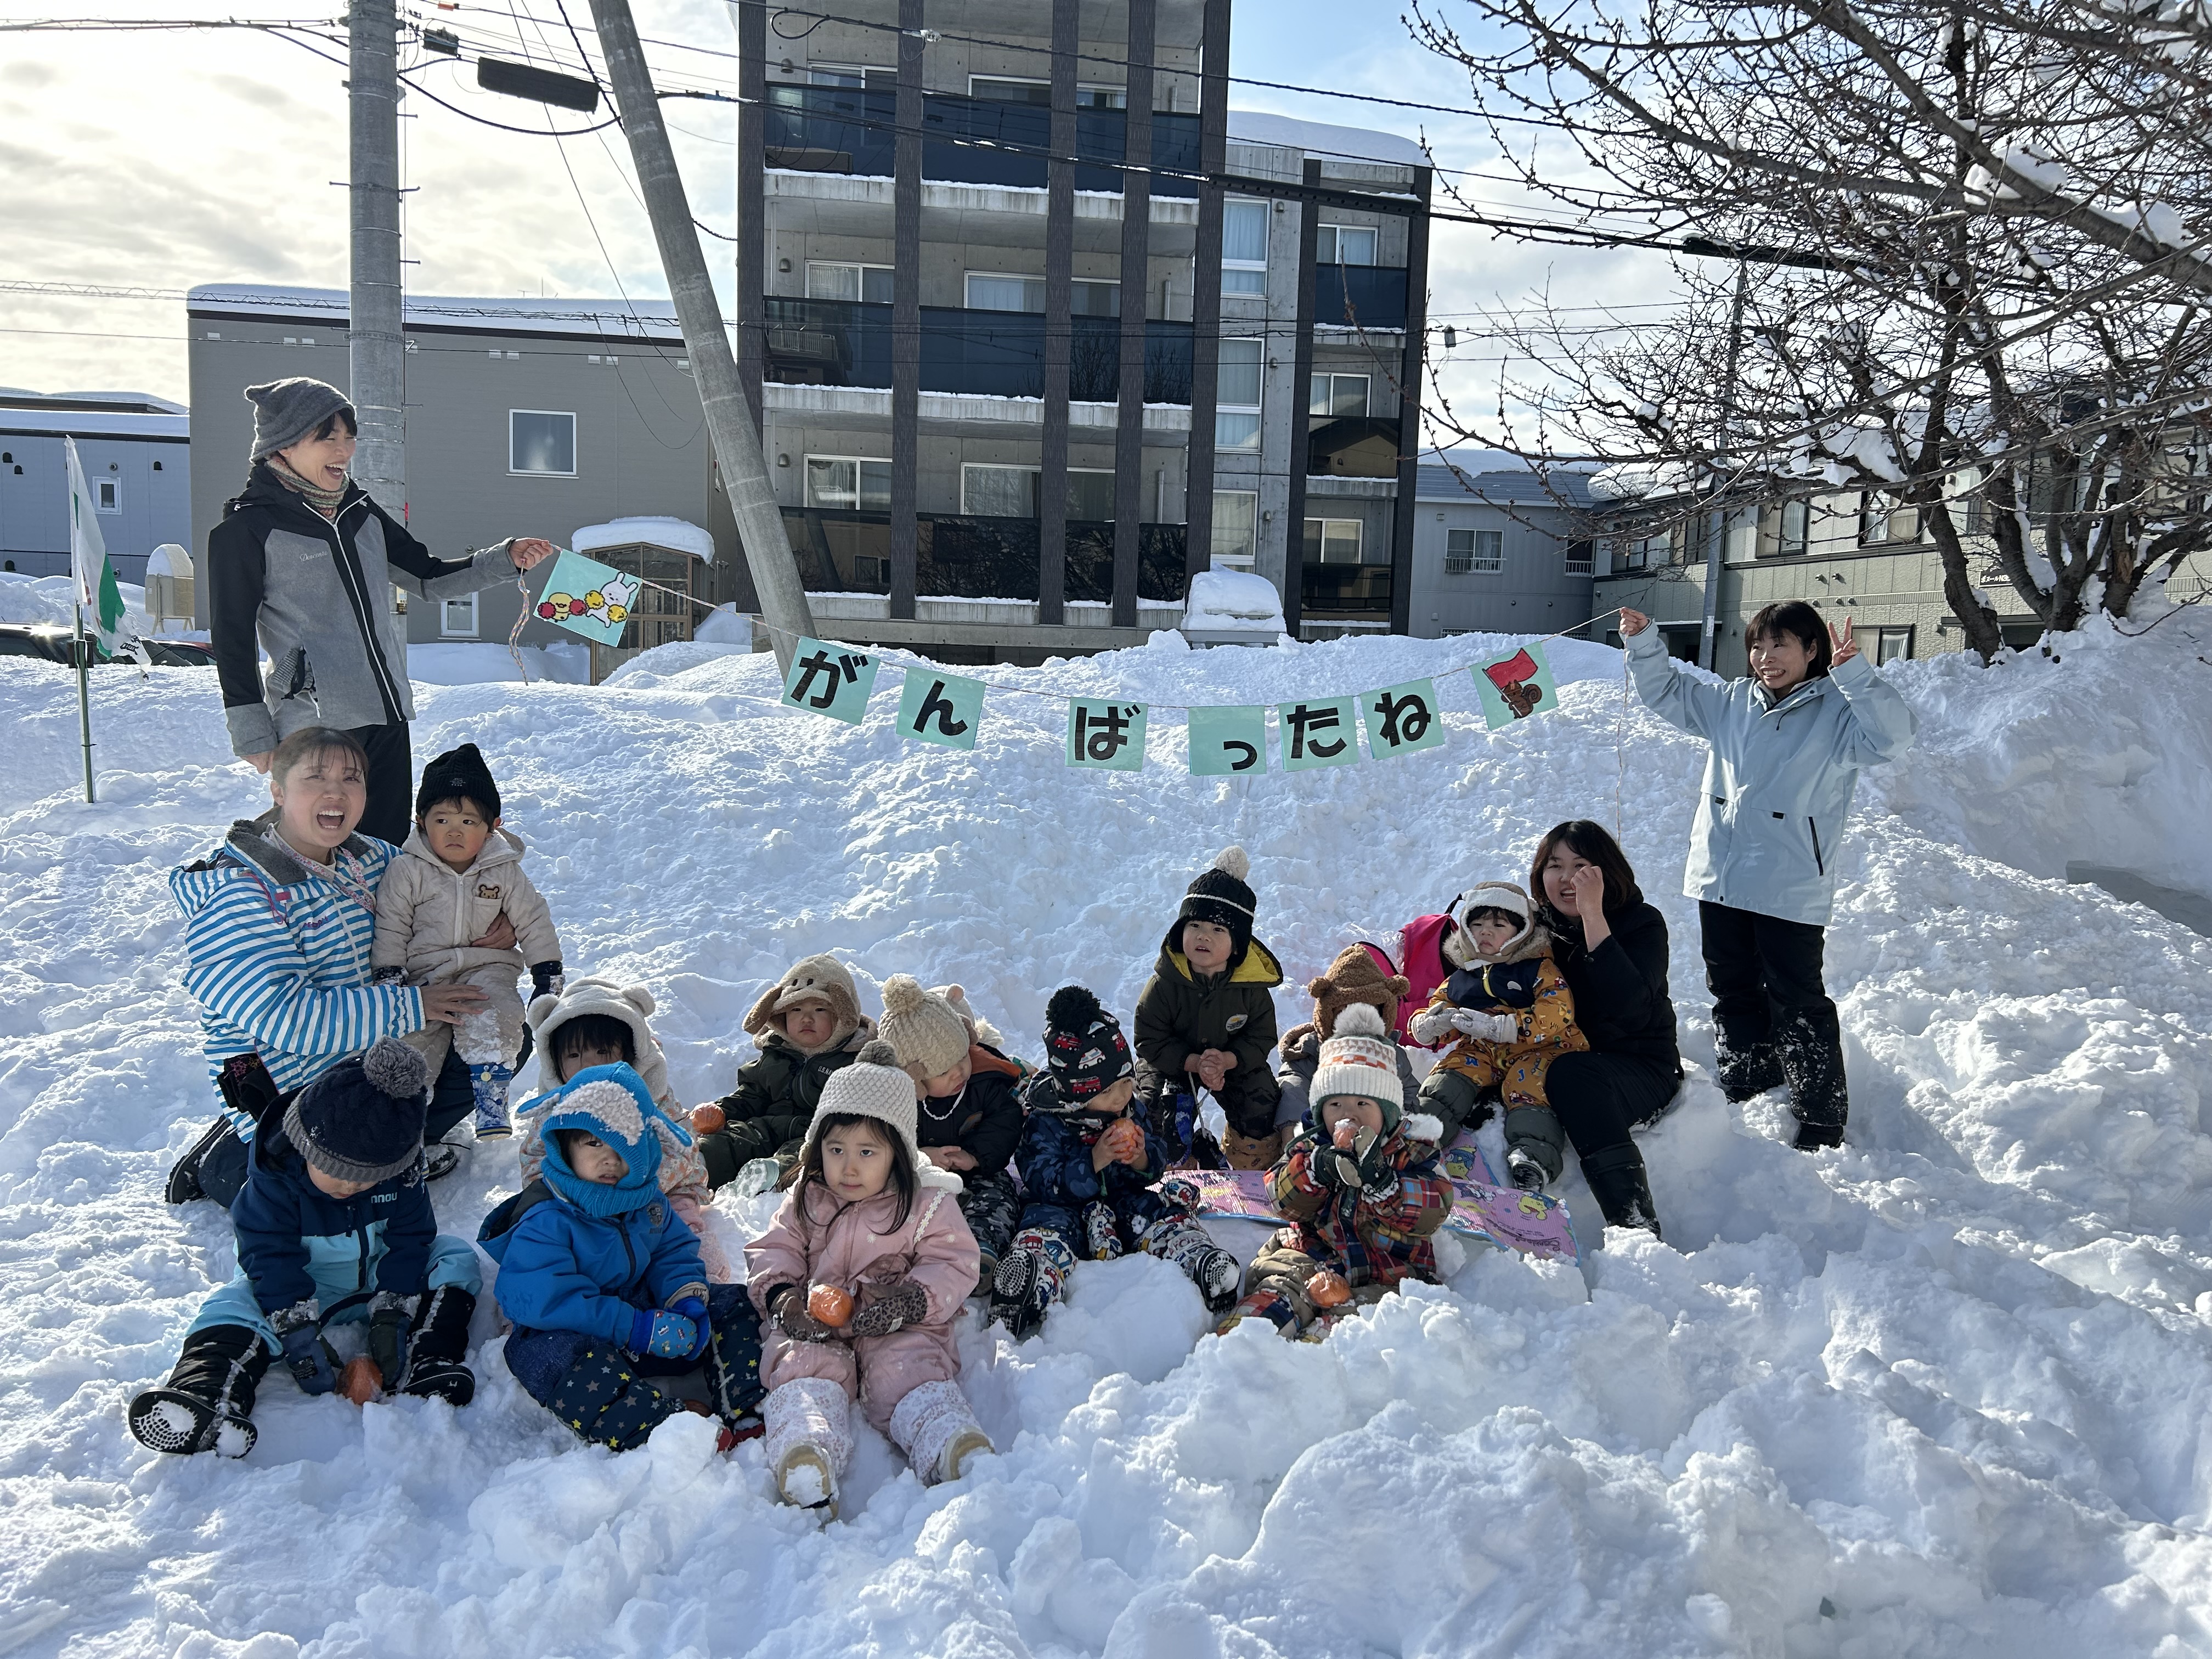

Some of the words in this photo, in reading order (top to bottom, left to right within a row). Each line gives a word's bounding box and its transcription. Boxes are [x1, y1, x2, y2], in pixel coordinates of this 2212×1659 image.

[300, 551, 328, 562] Descente
[791, 650, 1432, 770] がんばったね
[1517, 1068, 1526, 1083] J
